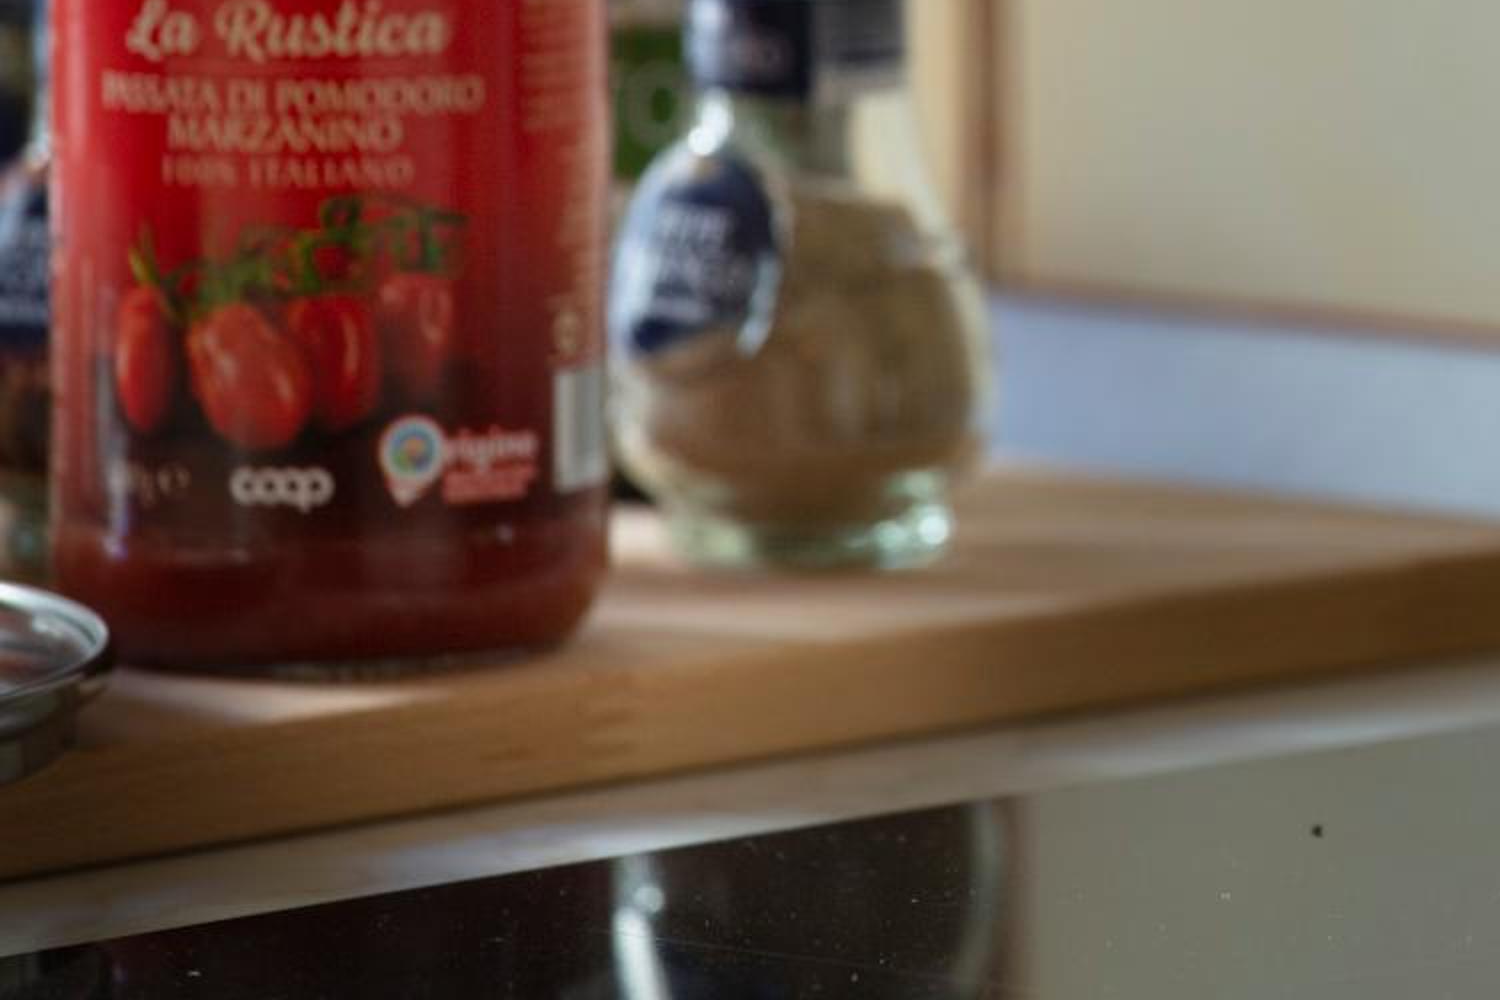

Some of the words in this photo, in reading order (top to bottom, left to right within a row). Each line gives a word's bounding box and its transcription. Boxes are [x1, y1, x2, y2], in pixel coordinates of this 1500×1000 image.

[227, 76, 266, 114] DI
[275, 74, 487, 116] POMODORO
[229, 464, 335, 514] coop
